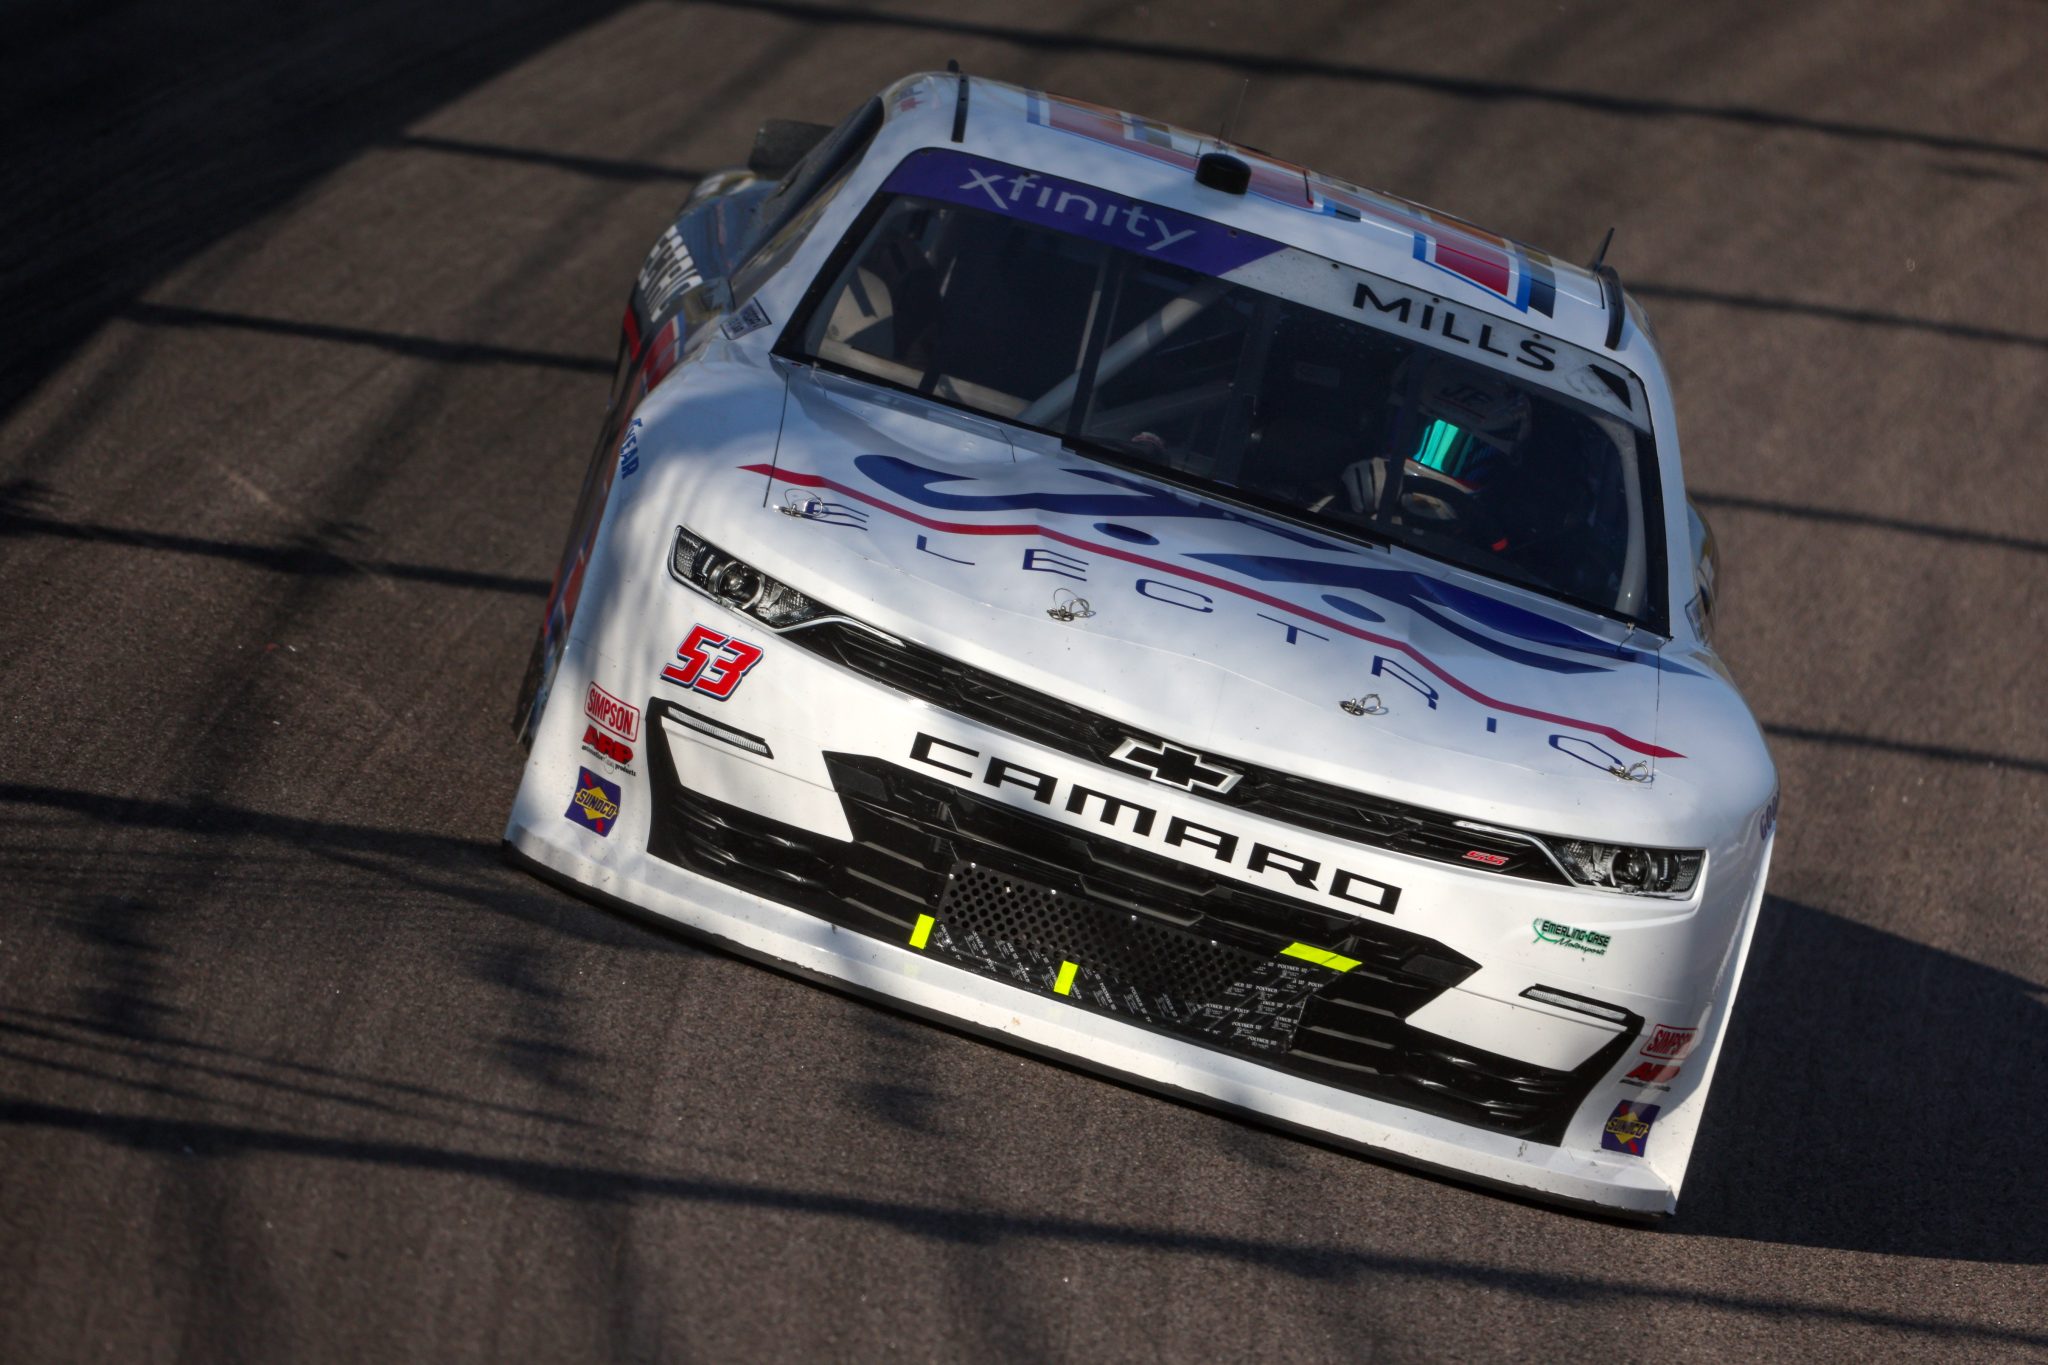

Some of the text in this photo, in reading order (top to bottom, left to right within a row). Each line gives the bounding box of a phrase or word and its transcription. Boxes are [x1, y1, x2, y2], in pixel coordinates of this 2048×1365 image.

[958, 168, 1197, 252] xfinity
[1351, 282, 1558, 373] MILLS
[659, 622, 765, 702] 53
[804, 499, 1624, 774] ELECTRIC
[581, 723, 635, 766] ARP
[586, 687, 635, 737] SIMPSON
[576, 790, 619, 819] SUNOCO
[614, 763, 637, 778] products
[908, 730, 1403, 915] CAMARO
